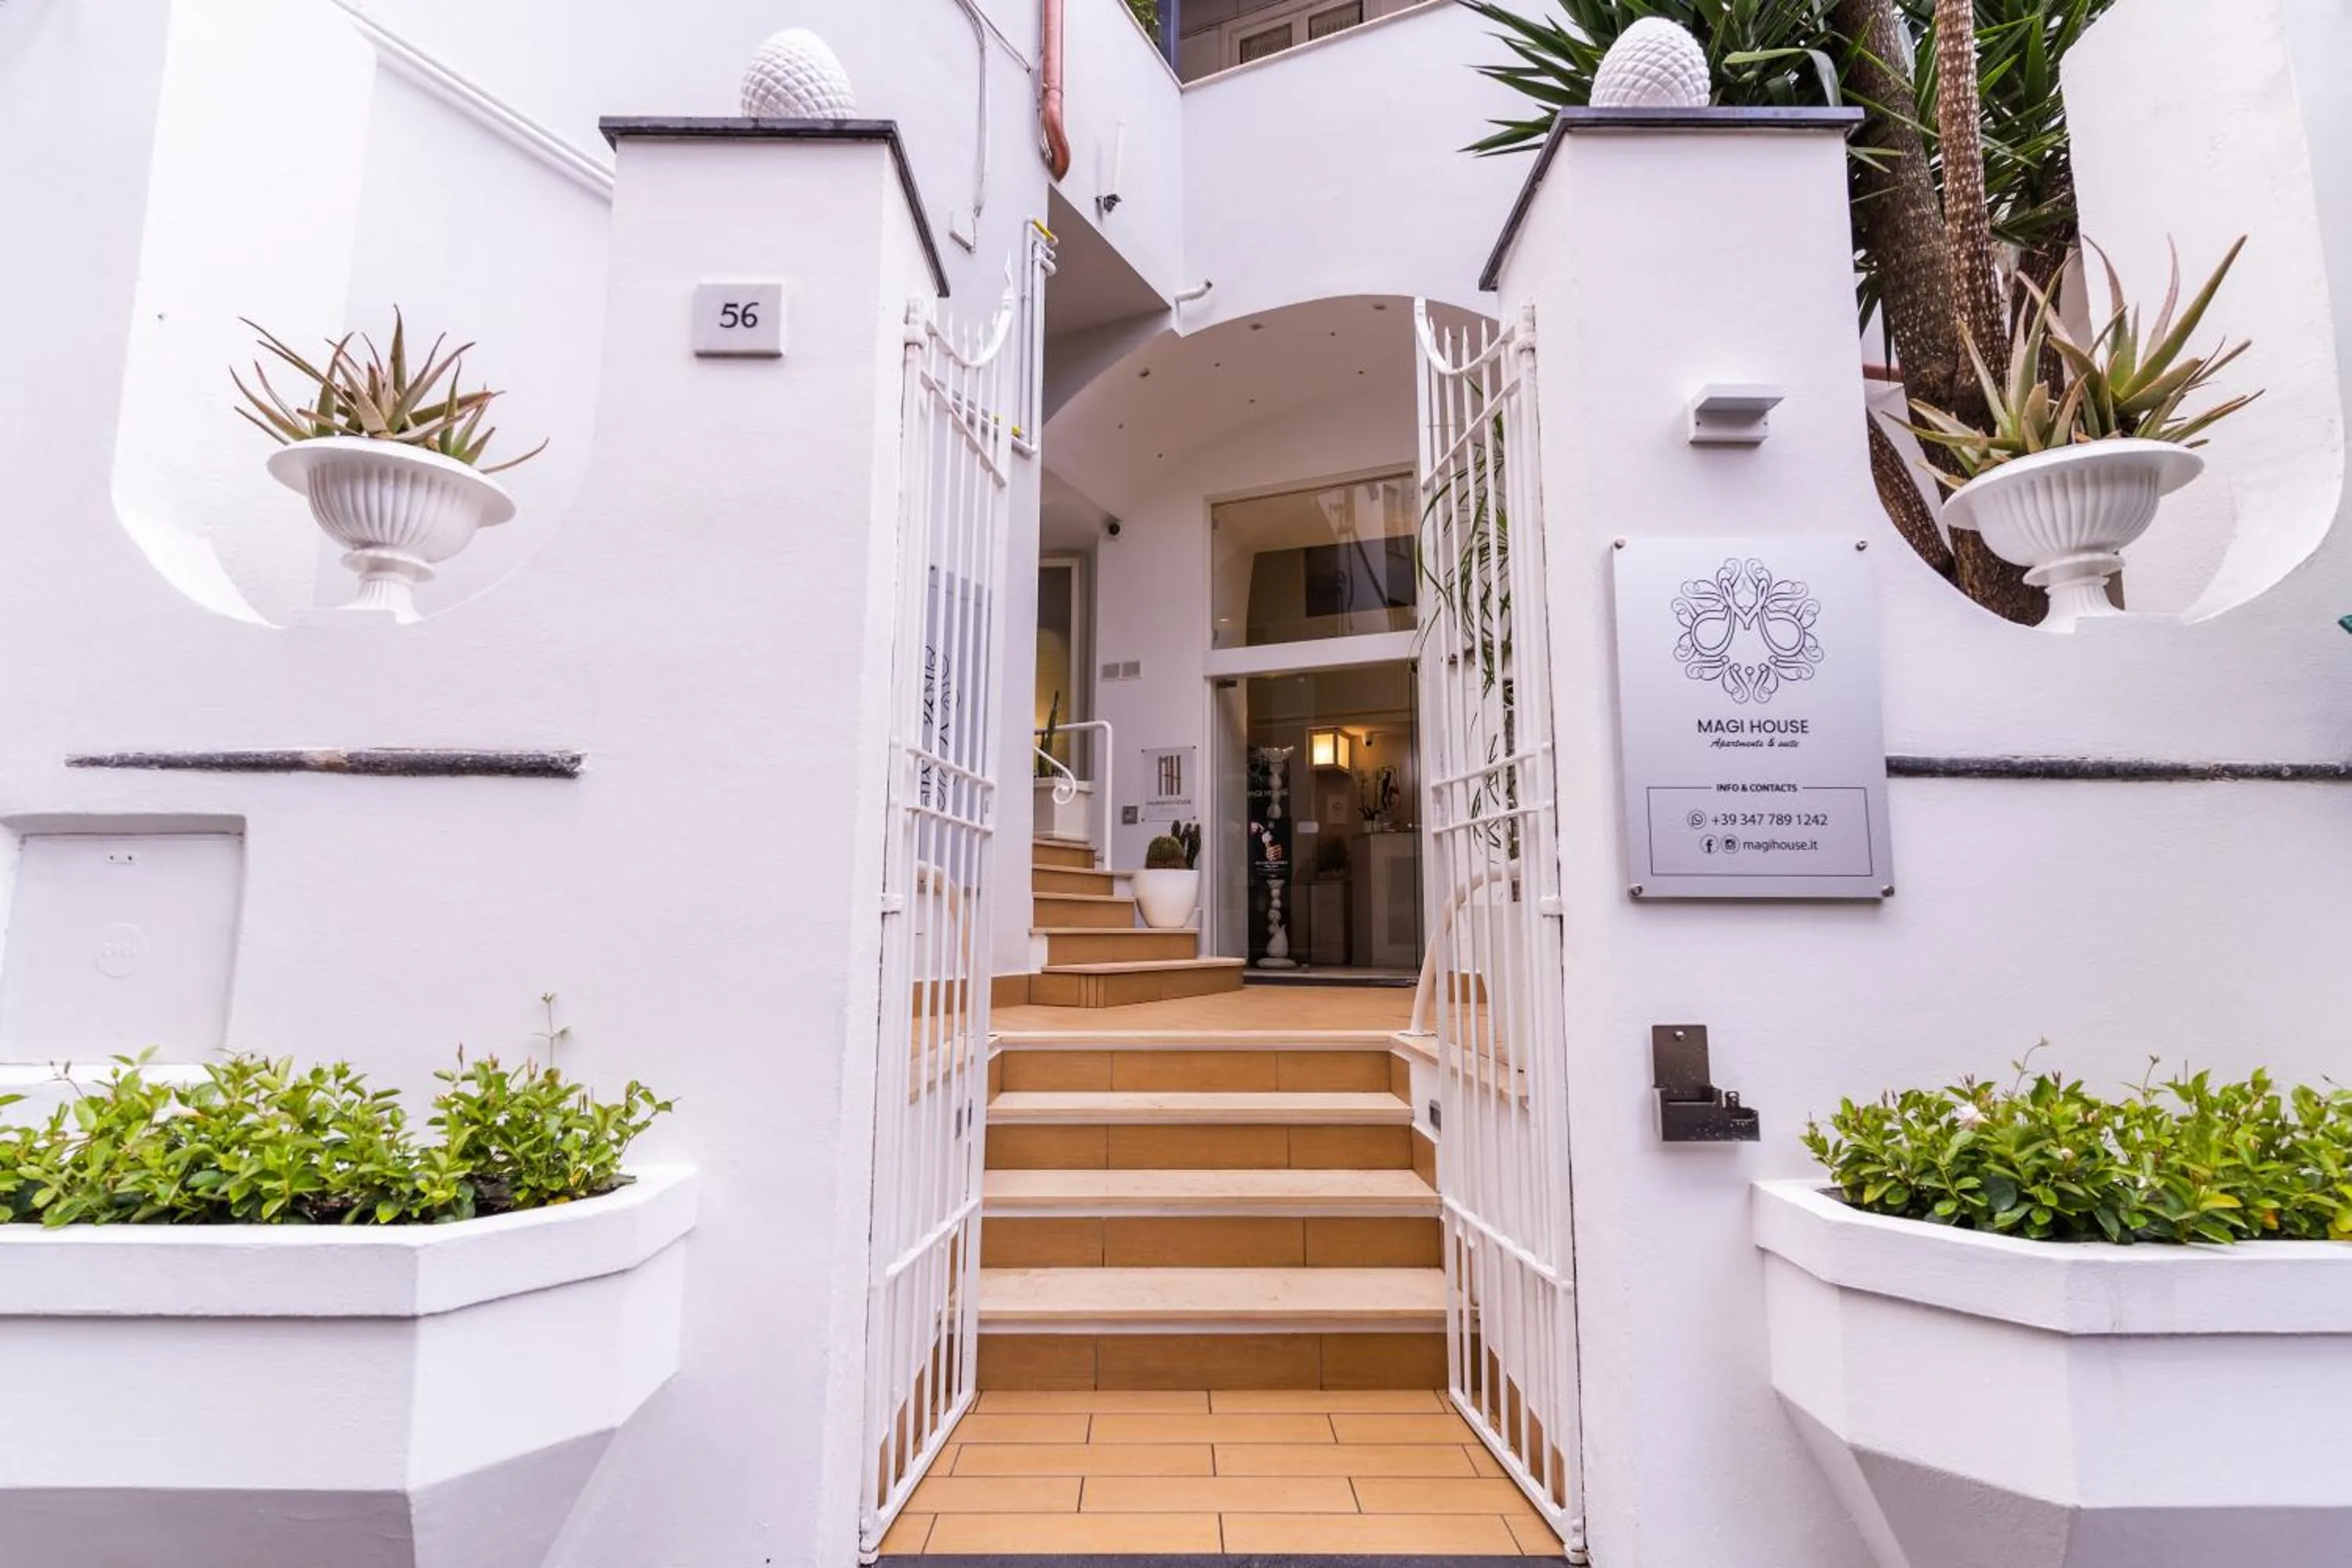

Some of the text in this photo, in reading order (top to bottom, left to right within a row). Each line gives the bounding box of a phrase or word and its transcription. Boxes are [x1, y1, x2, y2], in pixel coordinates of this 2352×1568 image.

[720, 302, 760, 328] 56
[1697, 719, 1809, 733] MAGI HOUSE
[1710, 738, 1763, 748] Apartments
[1716, 784, 1798, 793] INFO & CONTACTS
[1711, 813, 1828, 826] +39 347 789 1242
[1743, 840, 1819, 853] magihouse.it
